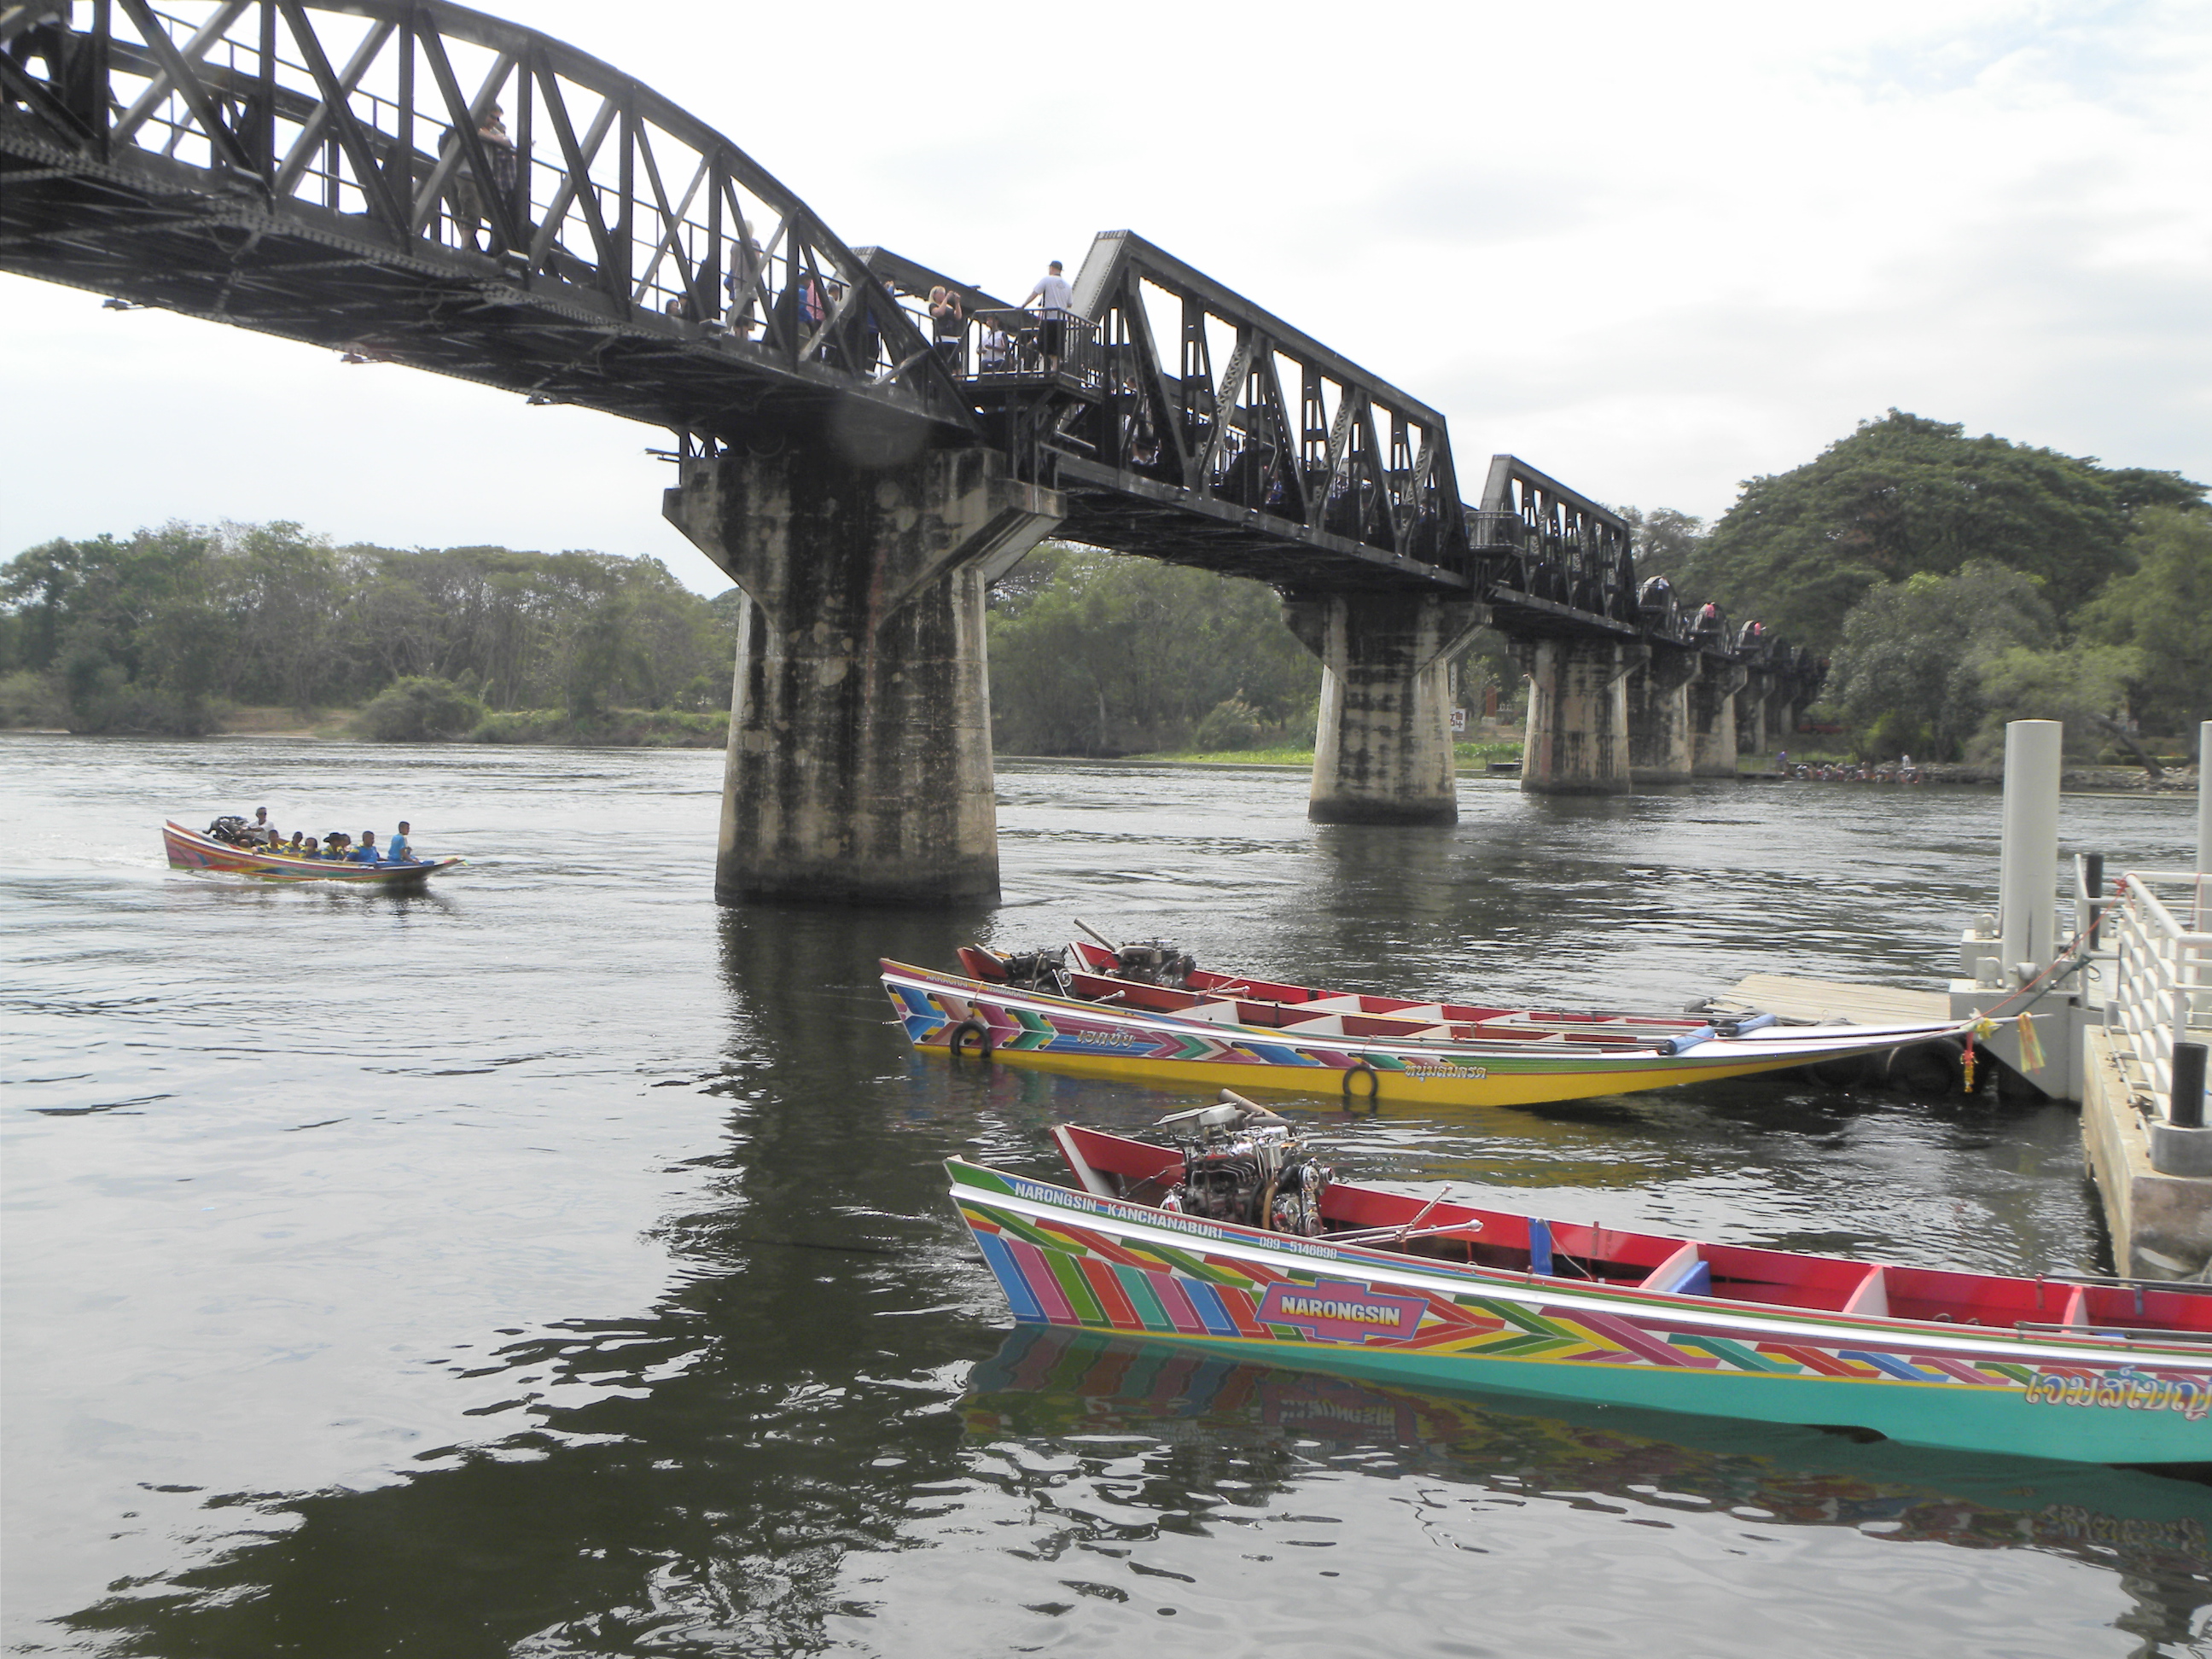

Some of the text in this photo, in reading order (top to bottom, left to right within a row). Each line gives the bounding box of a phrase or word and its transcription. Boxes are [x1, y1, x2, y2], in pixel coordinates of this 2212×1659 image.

[1015, 1182, 1223, 1239] NARONGSIN KANCHANABURI
[1260, 1236, 1338, 1260] 089 5146898
[1281, 1295, 1401, 1327] NARONGSIN
